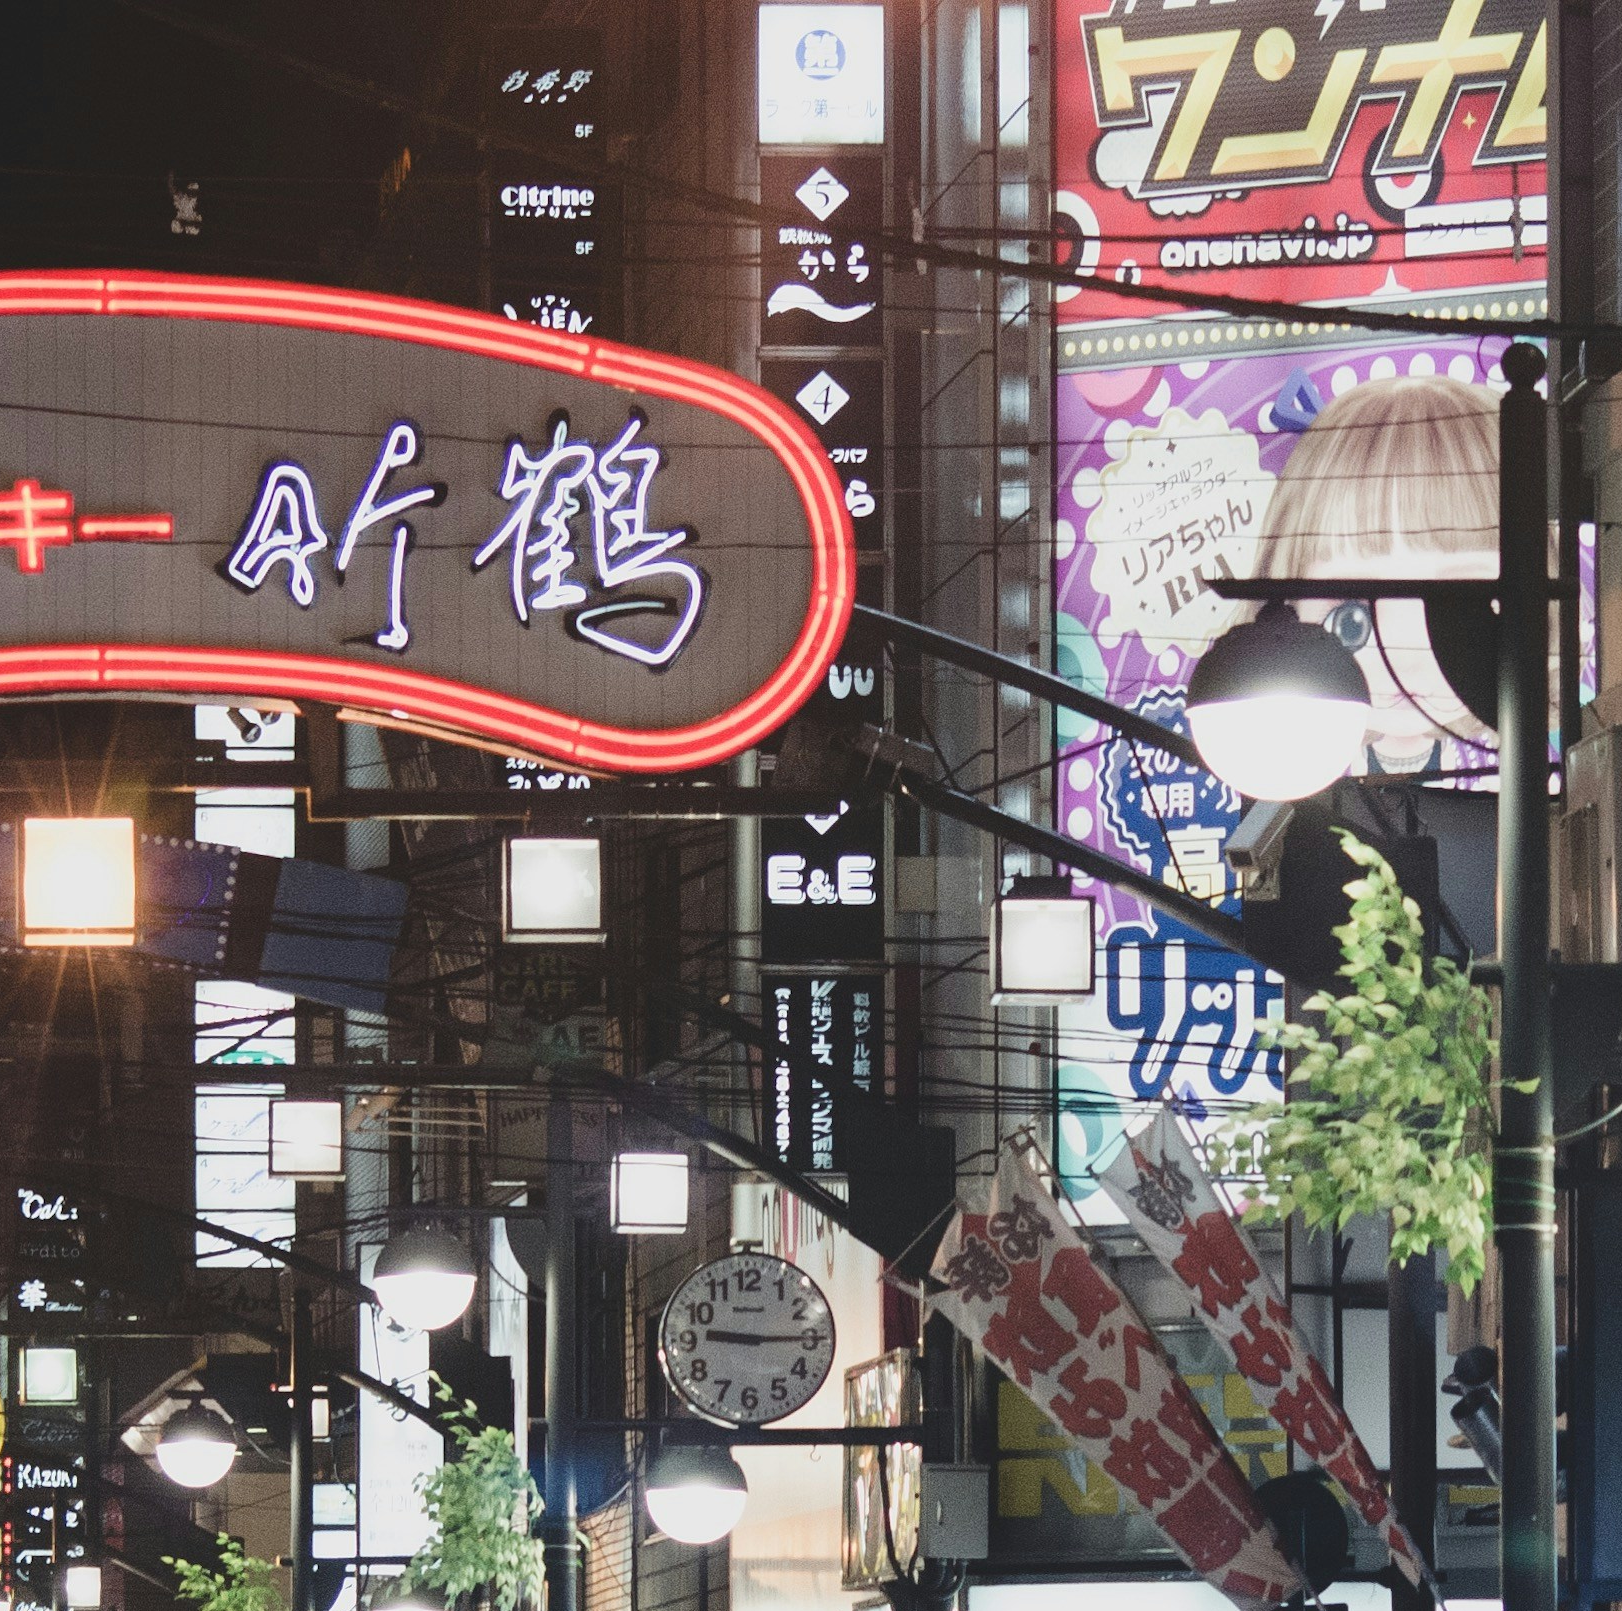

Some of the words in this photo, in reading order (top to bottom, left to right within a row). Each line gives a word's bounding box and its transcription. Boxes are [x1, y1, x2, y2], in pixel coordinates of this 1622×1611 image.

[574, 124, 594, 138] 5F
[814, 180, 832, 208] 5
[574, 241, 594, 255] 5F
[1160, 213, 1374, 269] onenavi.jp
[812, 384, 833, 415] 4
[1121, 497, 1253, 586] リアちゃん
[766, 854, 877, 905] E&E
[705, 1278, 729, 1301] 11
[732, 1268, 762, 1292] 12
[773, 1277, 785, 1301] 1
[685, 1301, 714, 1326] 10
[792, 1297, 809, 1321] 2
[679, 1330, 697, 1351] 9
[800, 1327, 819, 1351] 3
[690, 1359, 708, 1382] 8
[790, 1357, 808, 1380] 4
[713, 1379, 732, 1402] 7
[740, 1387, 759, 1410] 6
[770, 1377, 788, 1400] 5
